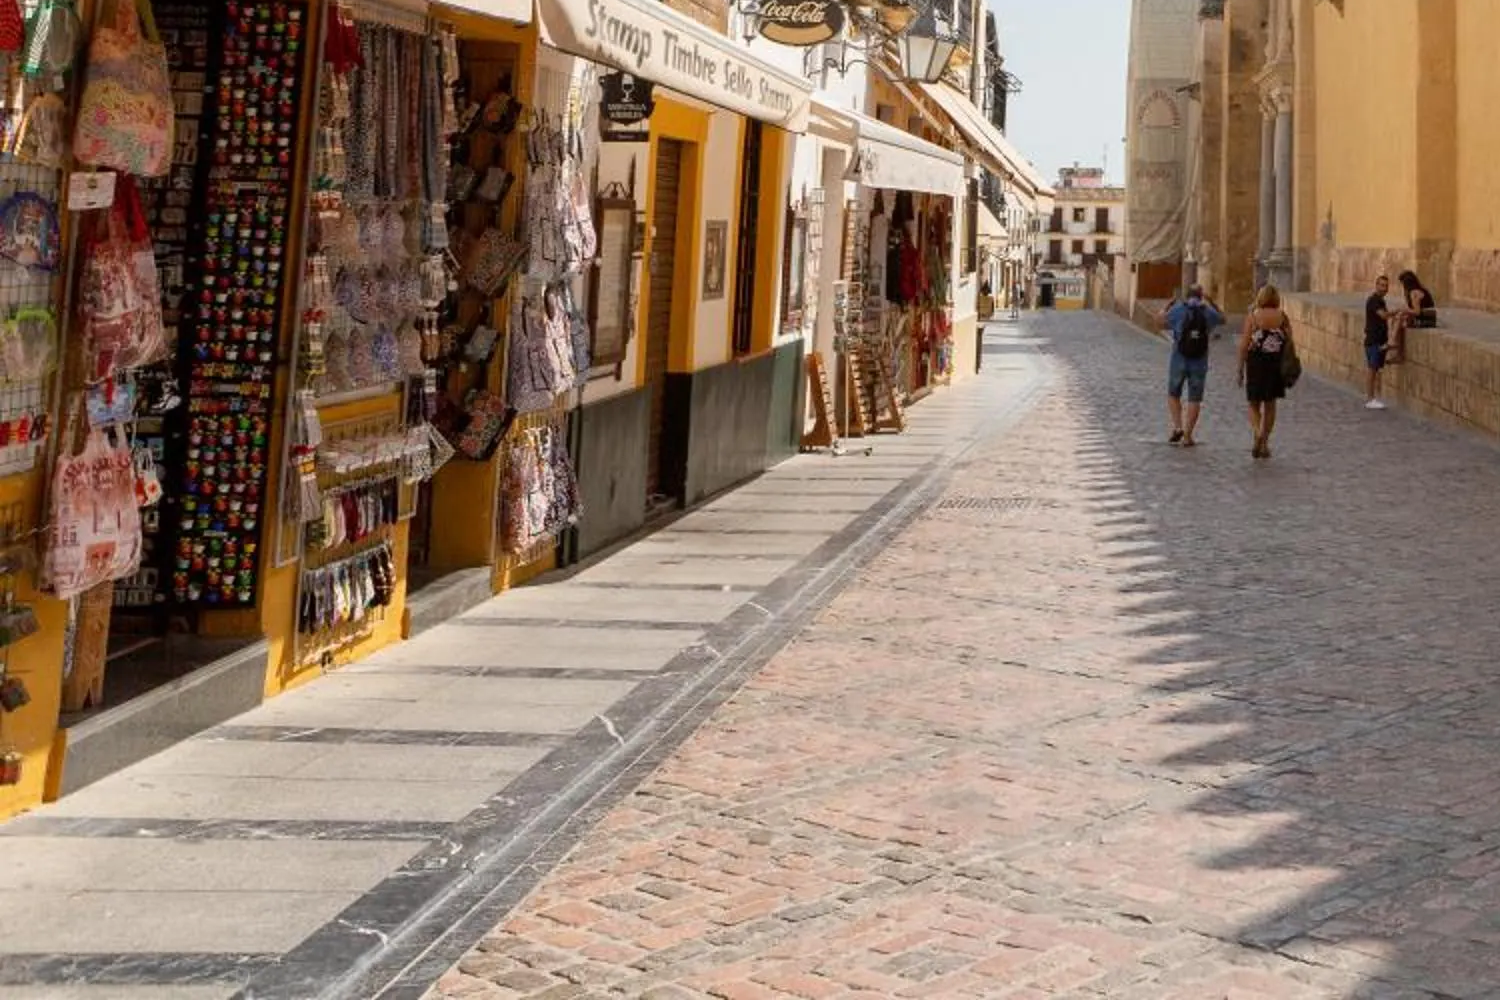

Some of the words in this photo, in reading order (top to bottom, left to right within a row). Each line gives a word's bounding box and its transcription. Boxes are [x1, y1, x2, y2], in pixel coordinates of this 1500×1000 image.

[662, 30, 716, 84] Timbre
[722, 60, 753, 99] Sello
[759, 78, 793, 119] Stamp
